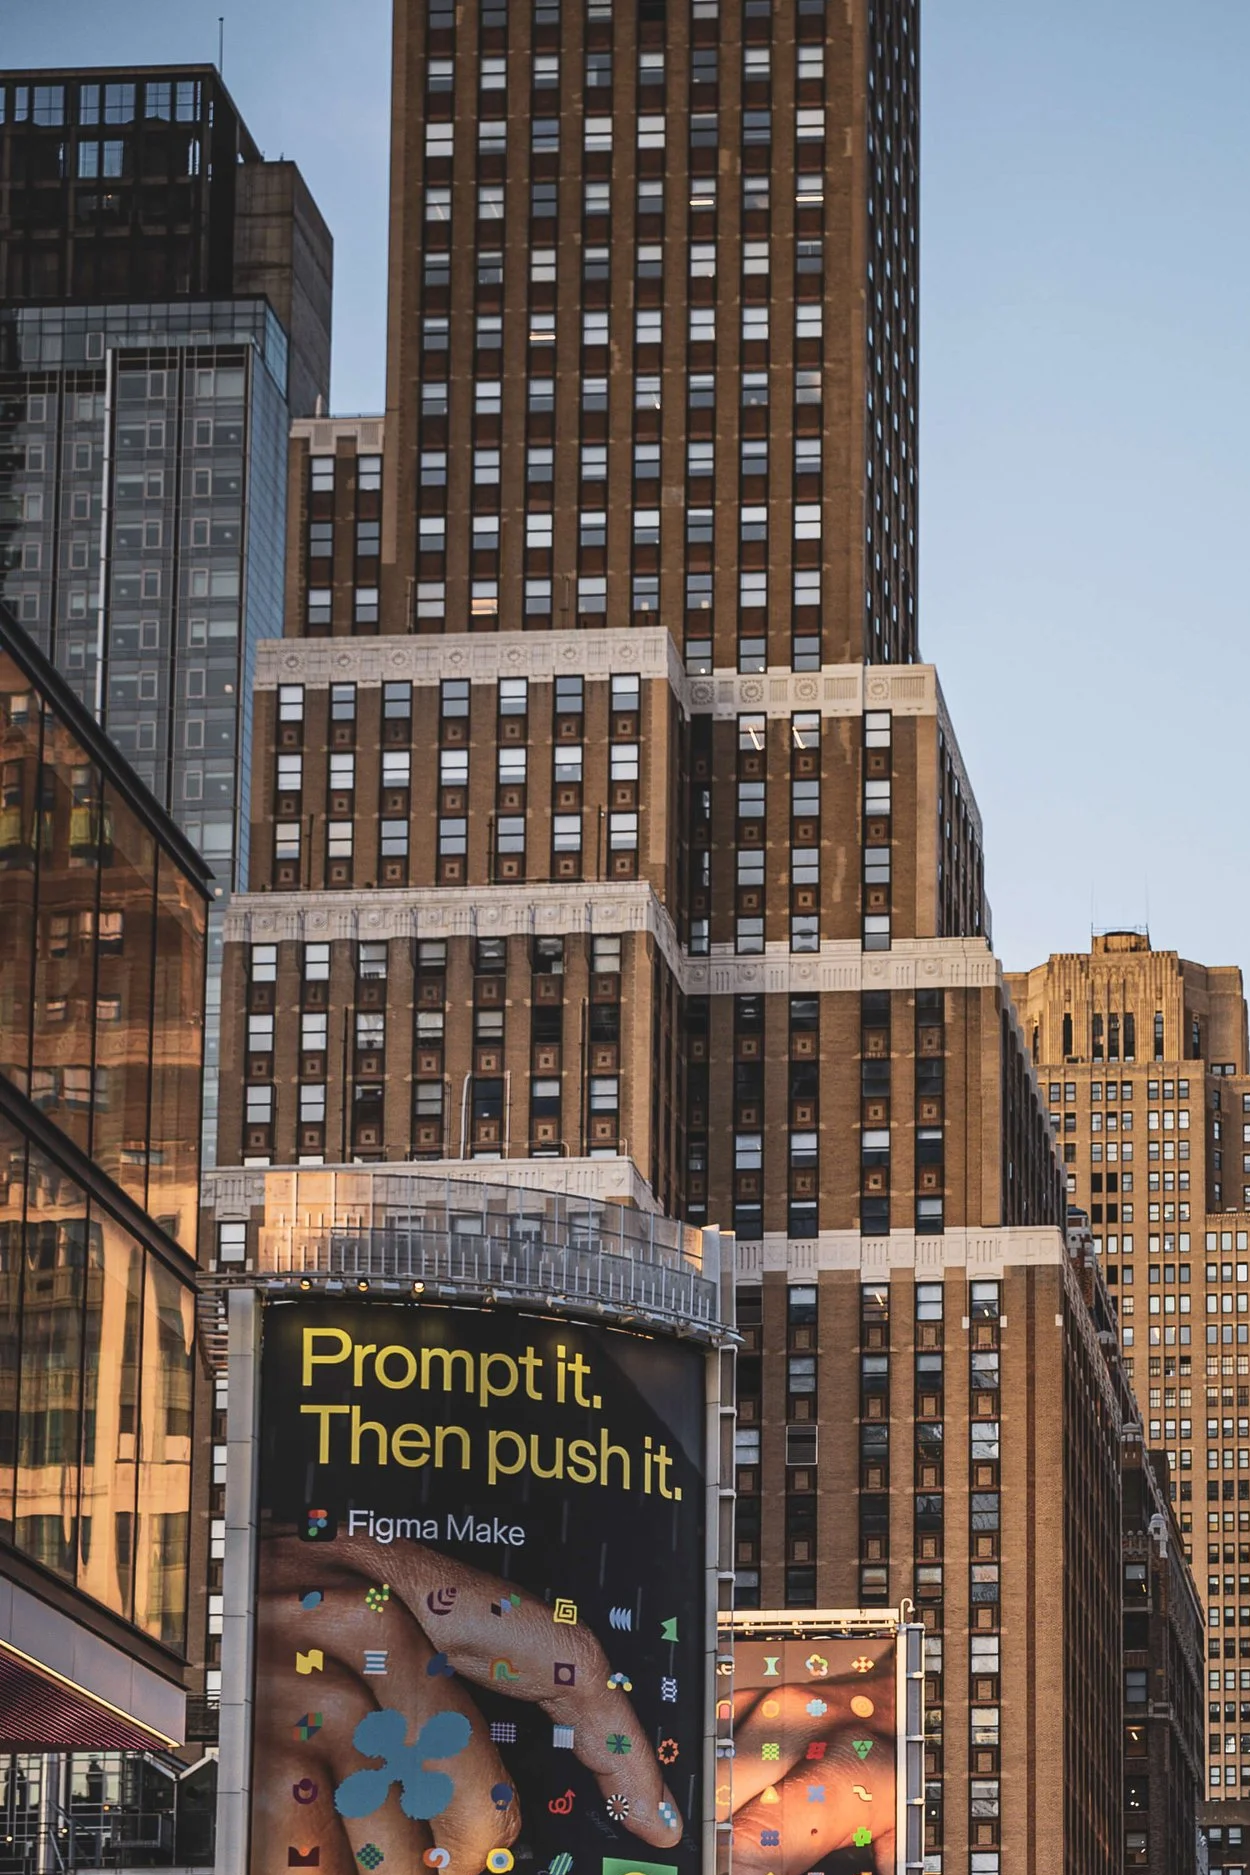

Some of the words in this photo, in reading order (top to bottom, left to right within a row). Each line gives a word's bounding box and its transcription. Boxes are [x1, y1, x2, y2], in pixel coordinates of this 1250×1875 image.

[301, 1327, 545, 1408] Prompt
[555, 1344, 603, 1409] it.
[300, 1404, 470, 1470] Then
[487, 1429, 630, 1490] push
[642, 1436, 683, 1501] it.
[347, 1509, 439, 1545] Figma
[446, 1515, 526, 1546] Make
